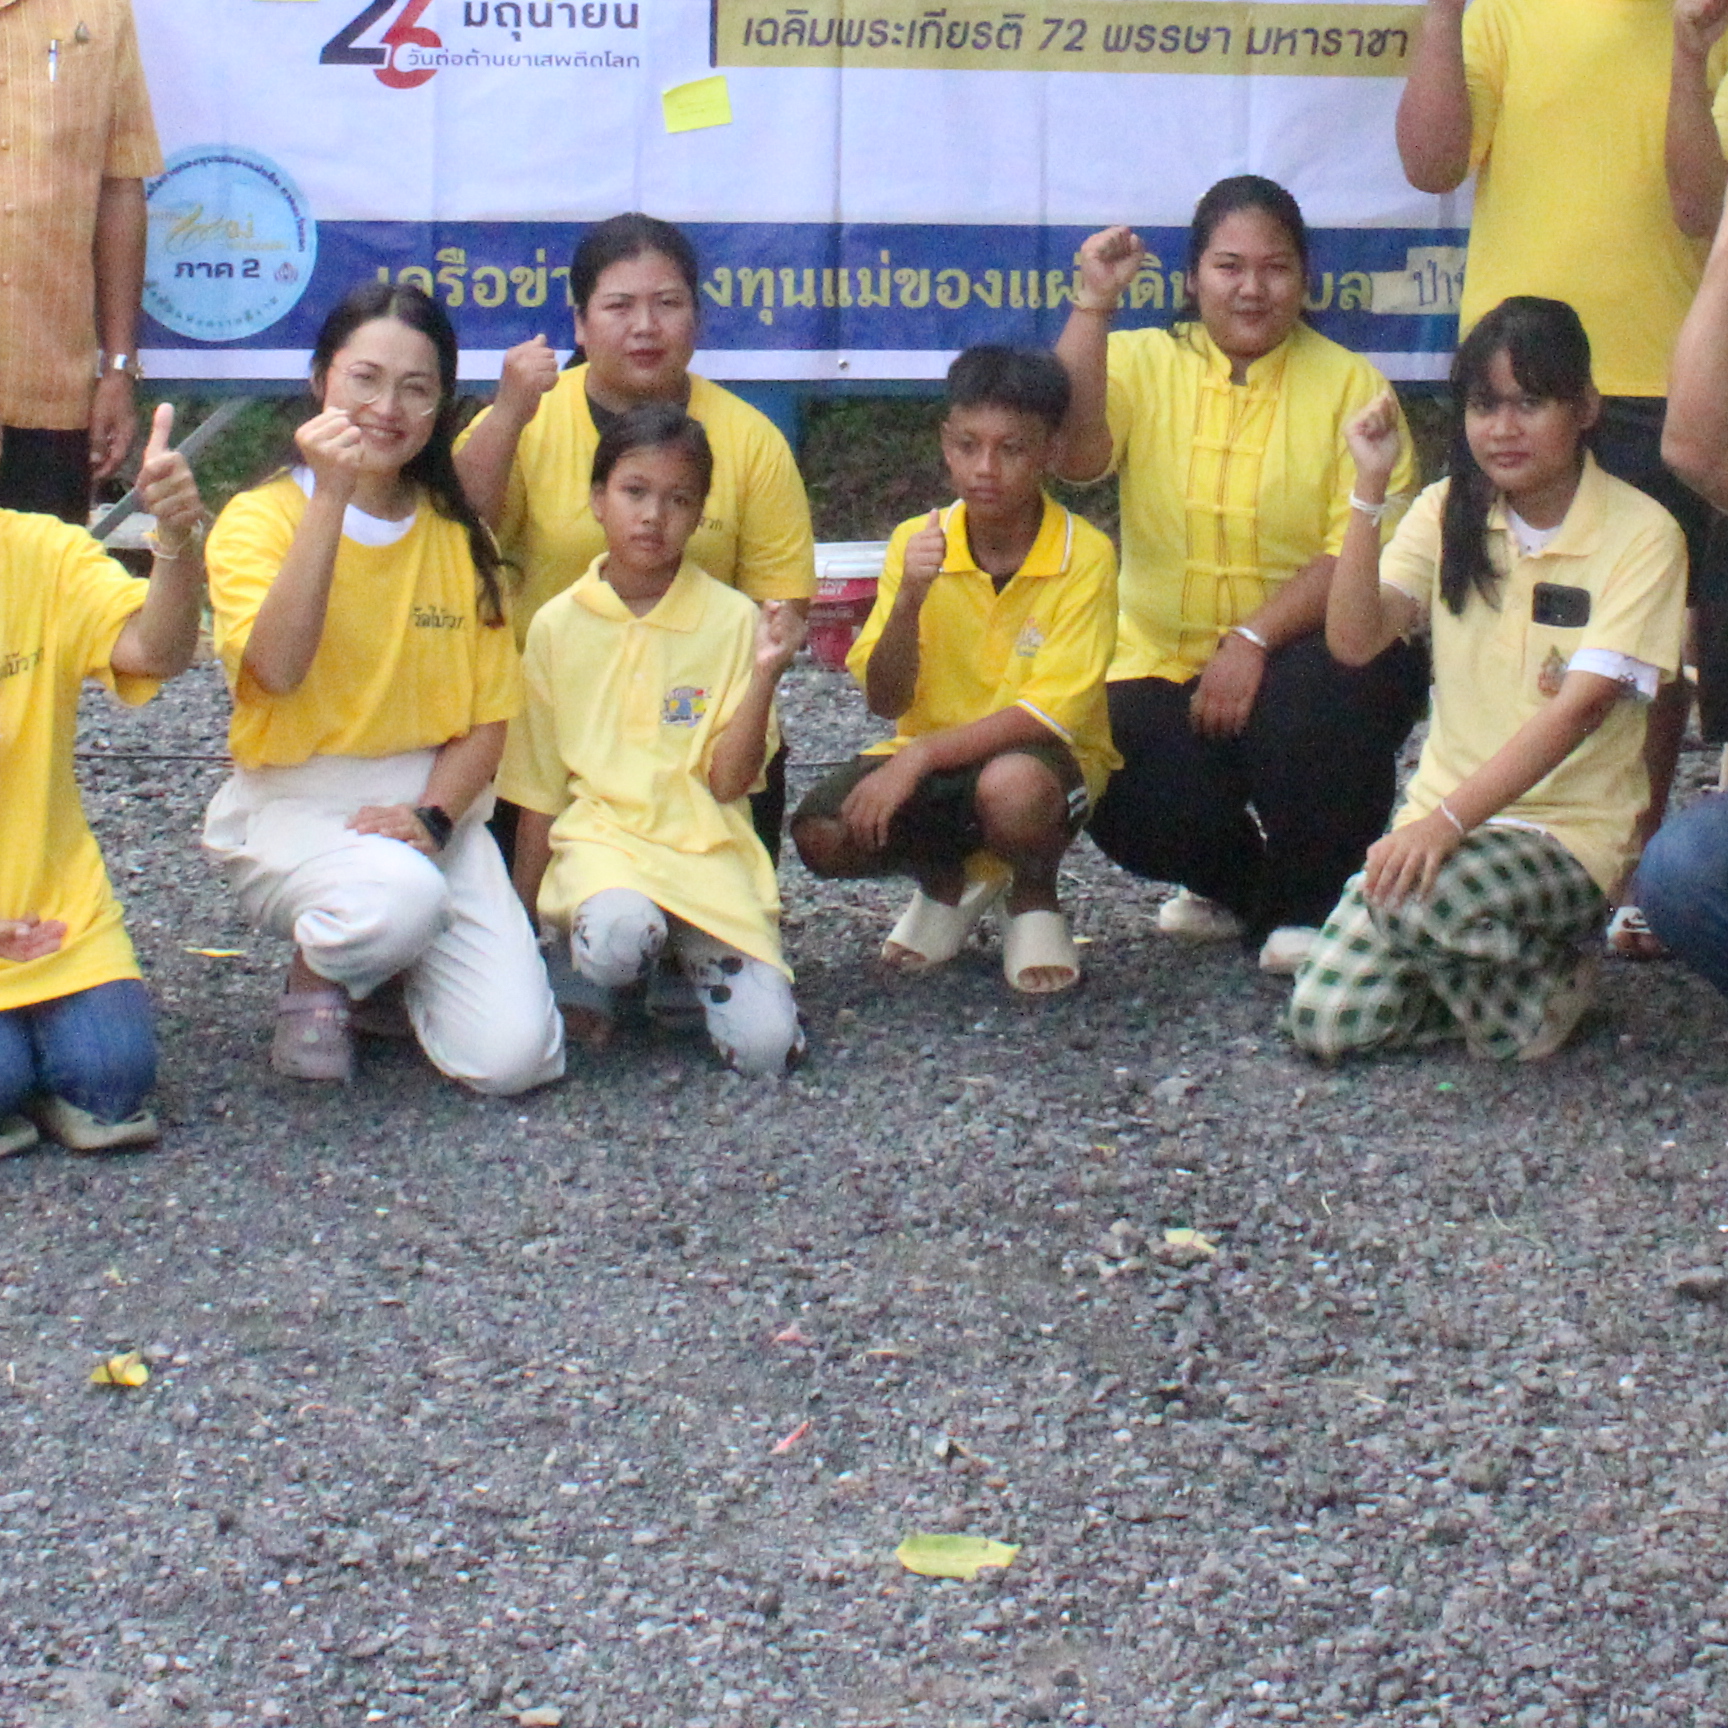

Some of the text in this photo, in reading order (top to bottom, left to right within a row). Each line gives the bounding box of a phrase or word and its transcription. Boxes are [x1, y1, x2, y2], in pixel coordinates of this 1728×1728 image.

[741, 7, 1410, 59] เฉลิมพระเกียรติ 72 พรรษา มหาราชา
[407, 46, 641, 69] วันต่อต้านยาเสพติดโลก
[174, 257, 261, 279] ภาค 2
